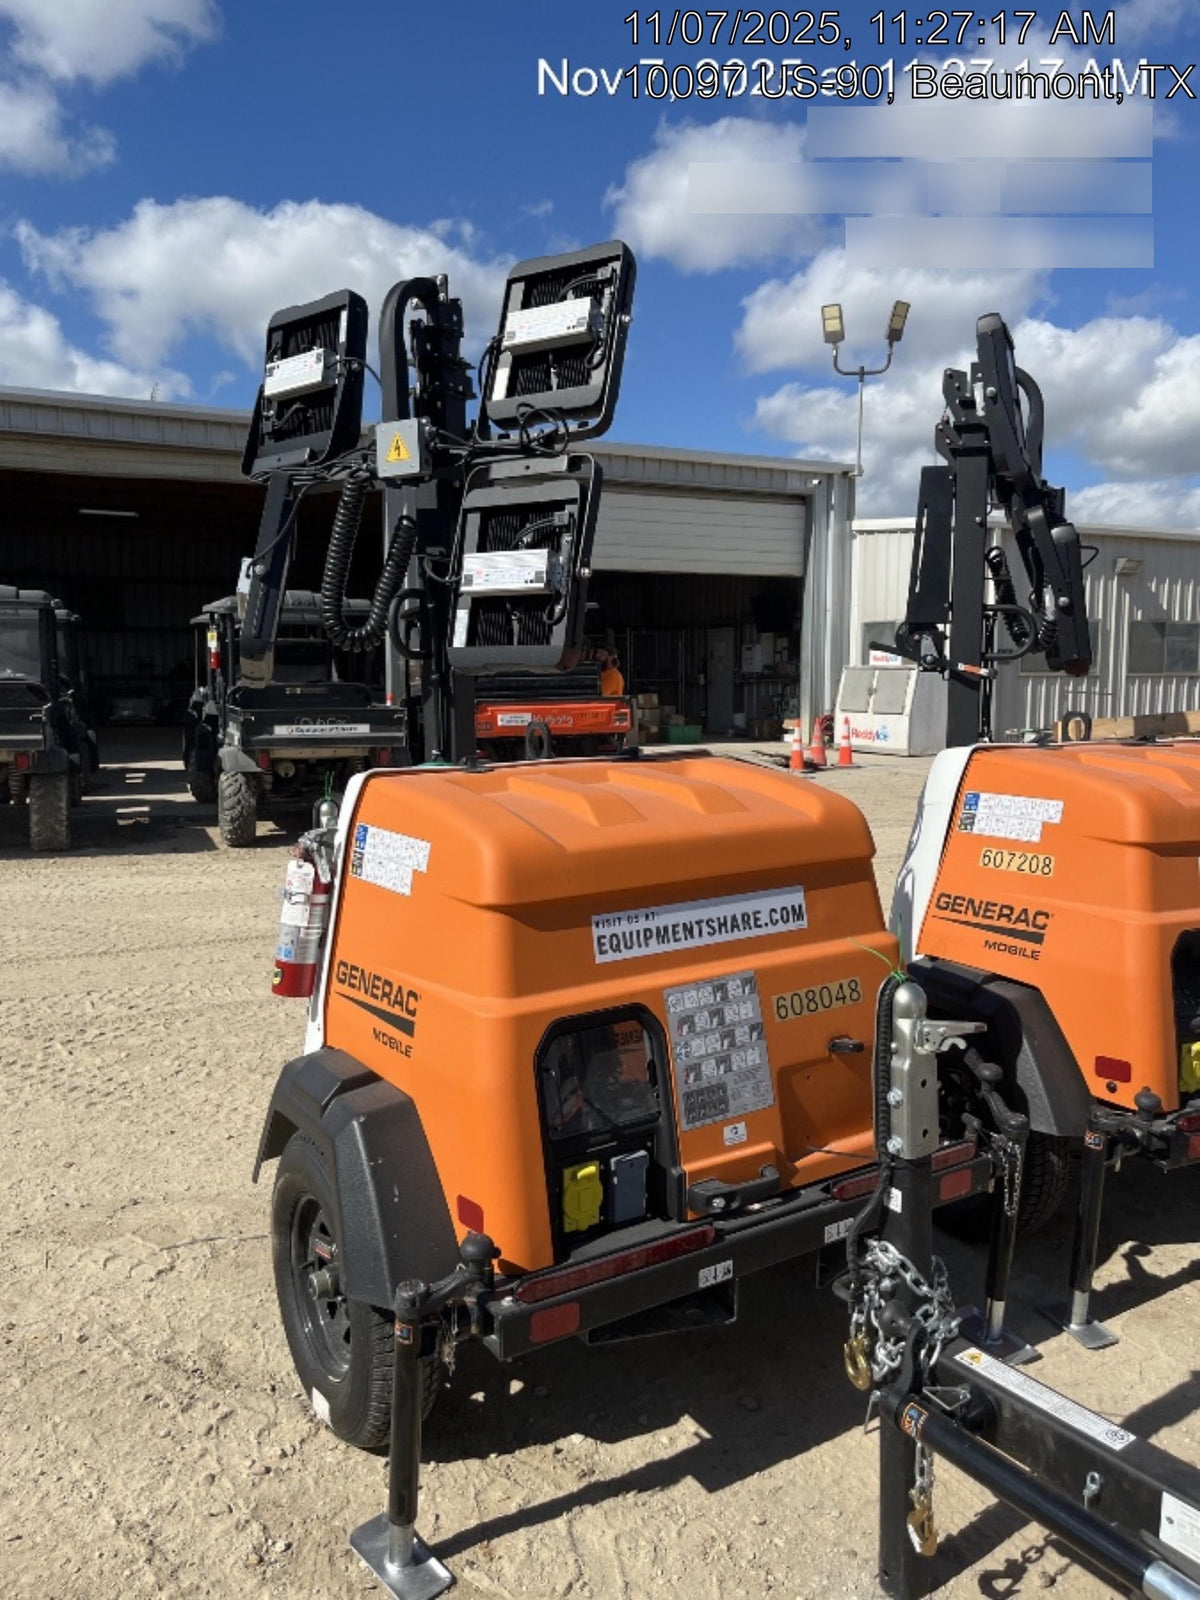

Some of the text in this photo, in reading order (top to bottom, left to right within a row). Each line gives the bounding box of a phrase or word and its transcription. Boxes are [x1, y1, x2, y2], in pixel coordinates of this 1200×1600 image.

[981, 848, 1053, 876] 607208
[597, 904, 805, 956] EQUIPMENTSHARE.COM
[935, 892, 1050, 930] GENERAC
[984, 939, 1041, 960] MOBILE
[336, 960, 420, 1018] GENERAC
[776, 978, 862, 1020] 608048
[372, 1026, 413, 1058] MOBILE
